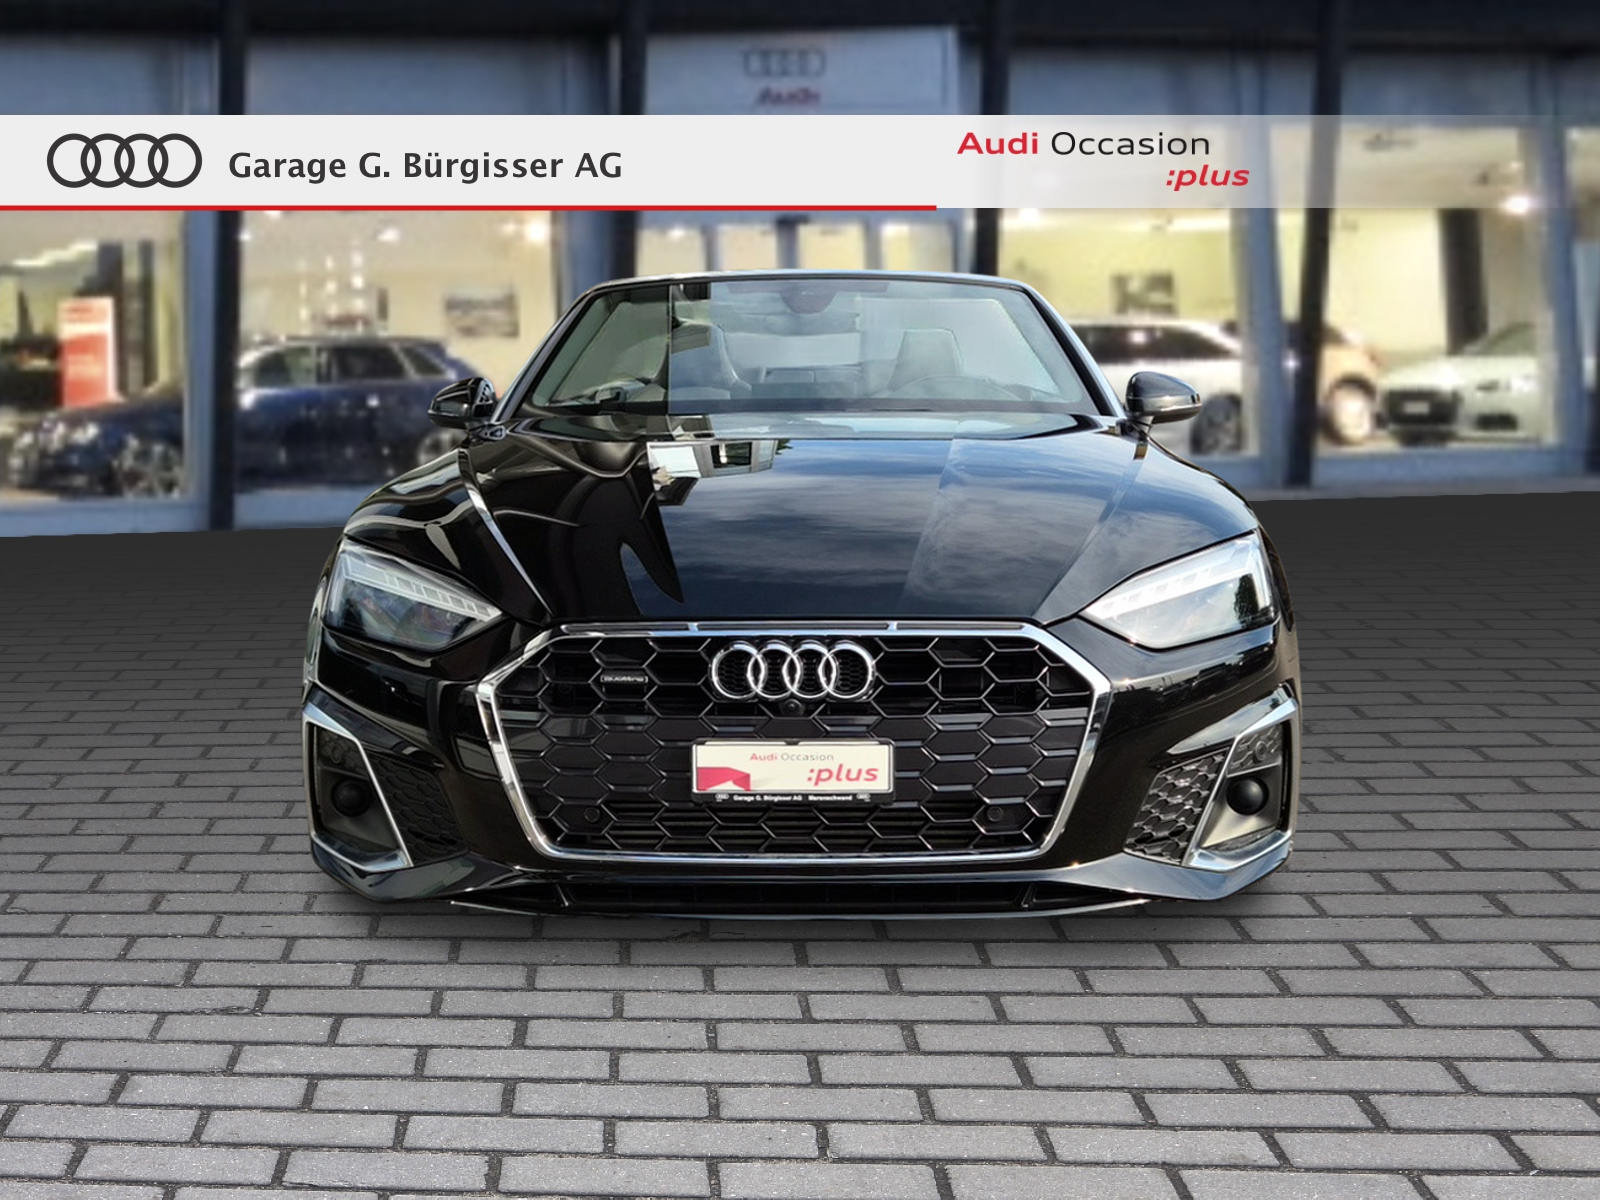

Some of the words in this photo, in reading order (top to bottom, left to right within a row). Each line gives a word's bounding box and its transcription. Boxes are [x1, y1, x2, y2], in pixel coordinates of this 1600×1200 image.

[750, 753, 778, 761] Audi
[781, 752, 834, 761] Occasion
[807, 763, 879, 786] :plus
